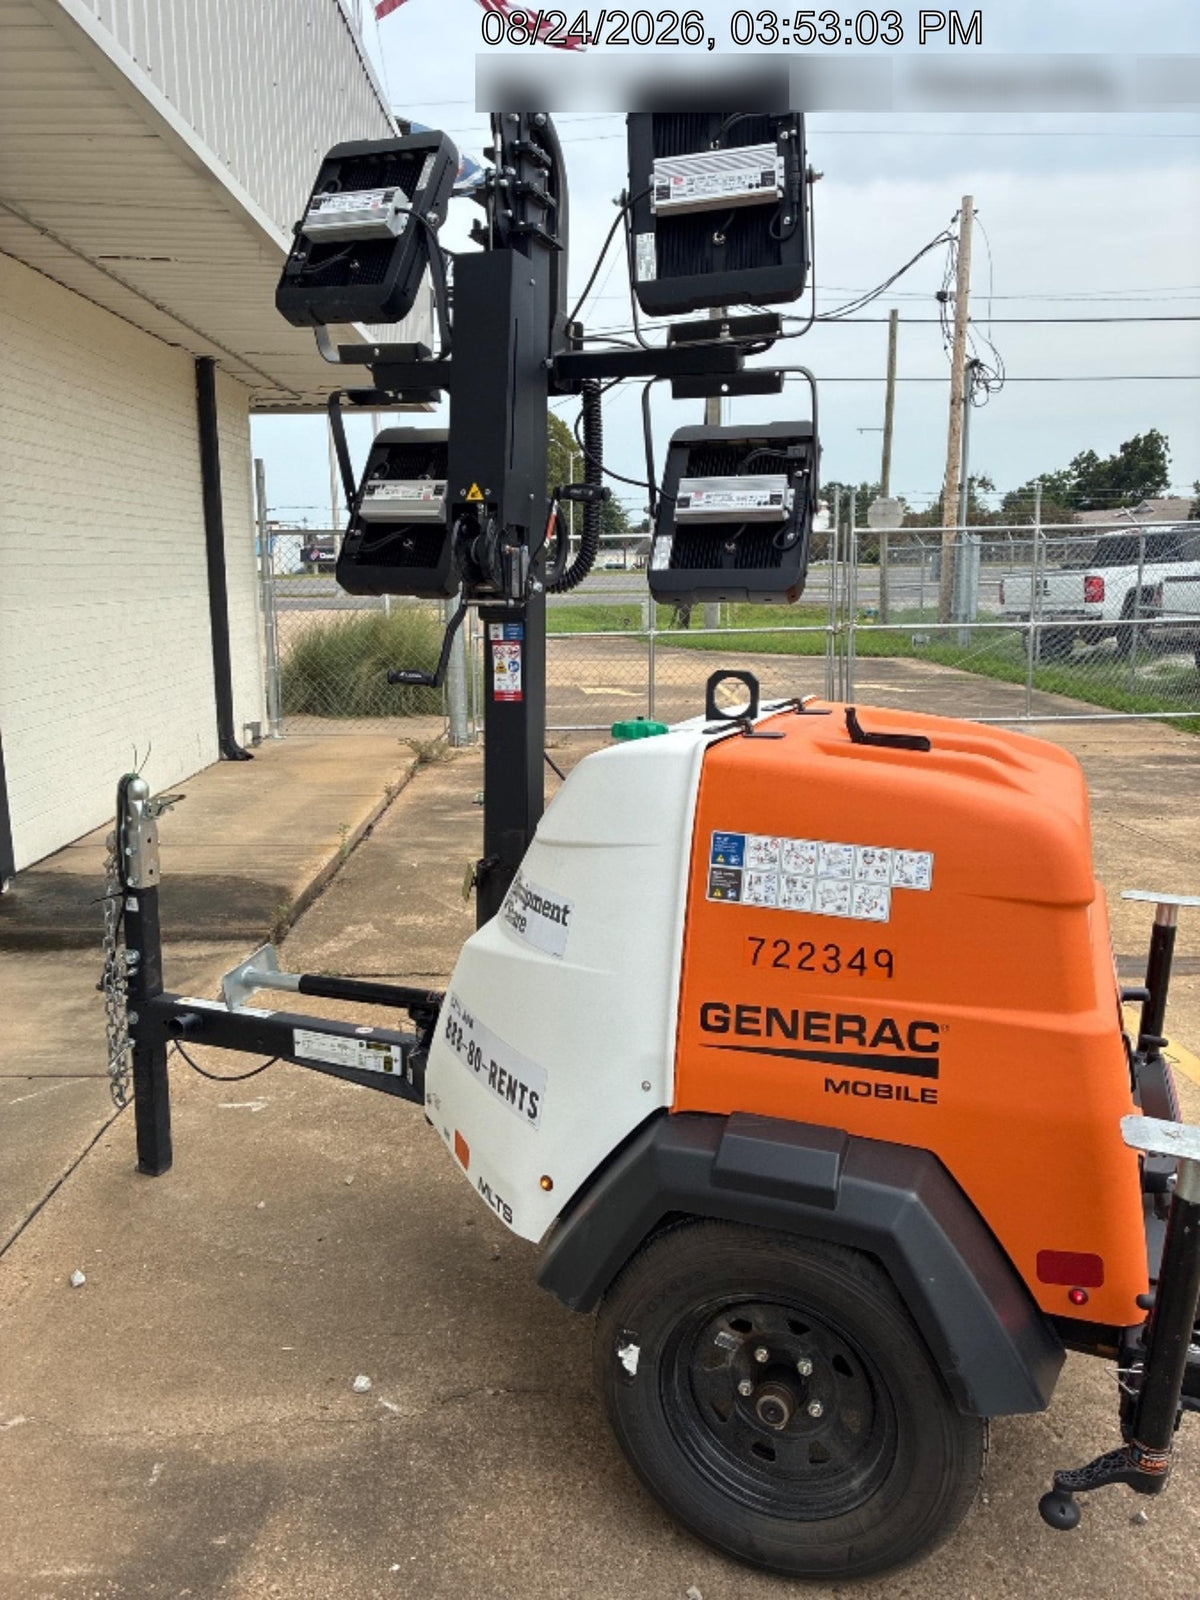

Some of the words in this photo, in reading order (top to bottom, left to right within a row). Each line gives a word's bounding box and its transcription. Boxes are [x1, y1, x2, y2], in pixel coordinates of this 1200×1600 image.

[748, 937, 894, 978] 722349
[700, 1002, 940, 1053] GENERAC
[824, 1077, 938, 1105] MOBILE
[478, 1176, 513, 1225] MLTS
